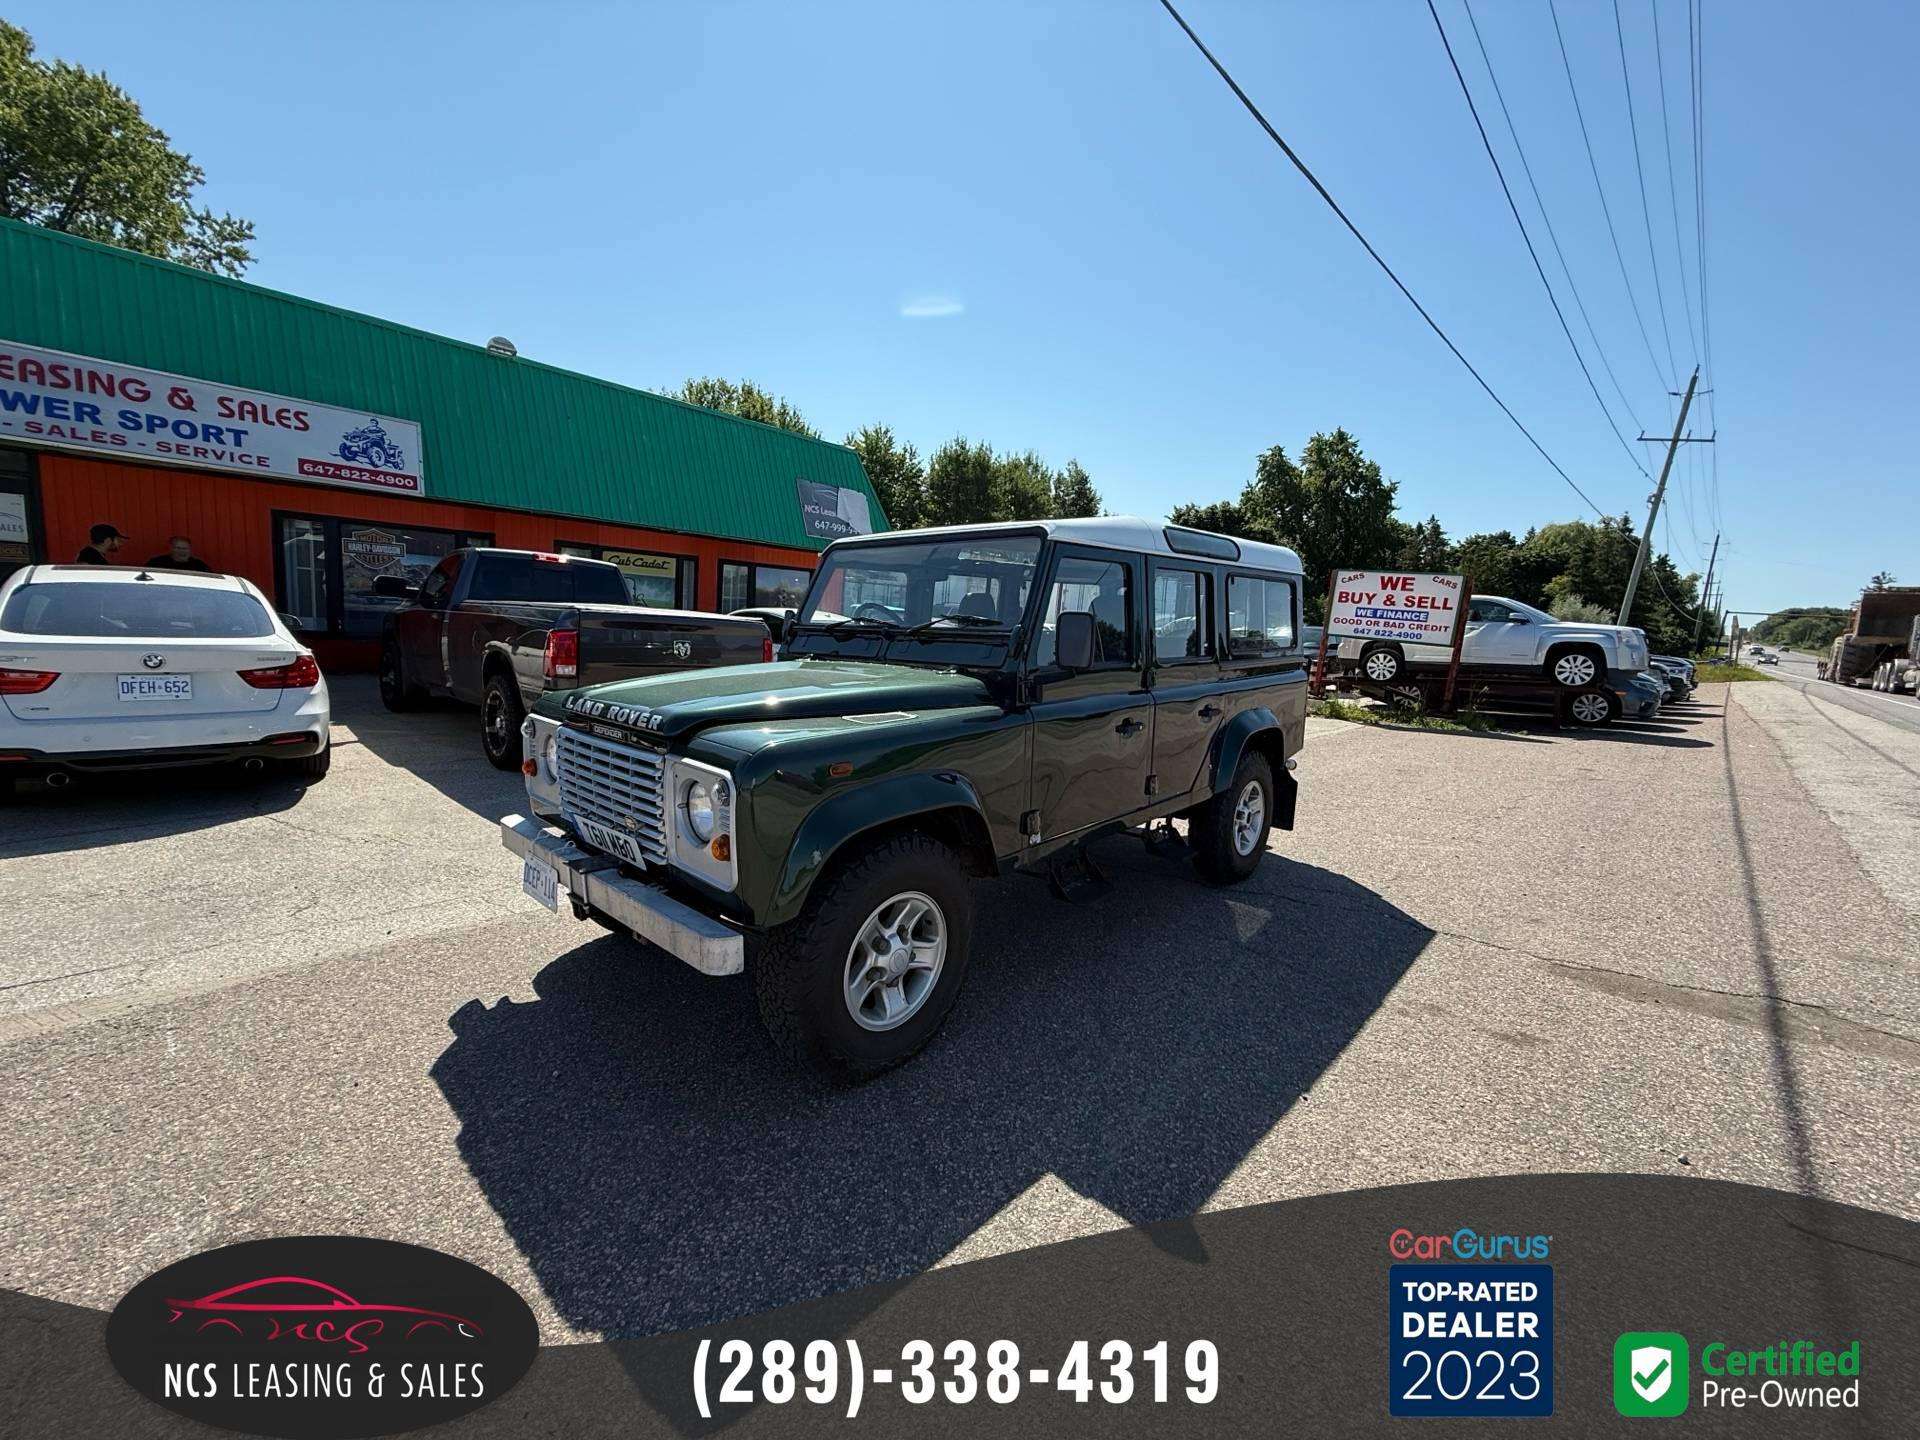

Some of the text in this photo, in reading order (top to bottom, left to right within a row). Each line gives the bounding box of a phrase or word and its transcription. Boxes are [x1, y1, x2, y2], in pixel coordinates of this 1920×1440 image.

[167, 386, 198, 413] &
[217, 396, 310, 432] SALES
[118, 408, 249, 448] SPORT
[25, 420, 127, 446] SALES
[156, 441, 270, 468] SERVICE
[303, 463, 415, 488] 647-822-4900
[804, 504, 820, 514] NCS
[608, 555, 671, 570] Cub Cadet
[1341, 572, 1365, 584] CARS
[1380, 575, 1416, 592] WE
[1432, 575, 1458, 590] CARS
[1337, 591, 1453, 611] BUY & SELL
[1356, 608, 1429, 621] WE FINANCE
[1333, 617, 1451, 633] GOOD OR BAD CREDIT
[1353, 627, 1423, 640] 647 822-4900
[565, 695, 663, 731] LAND ROVER
[594, 725, 623, 740] DEFENDER
